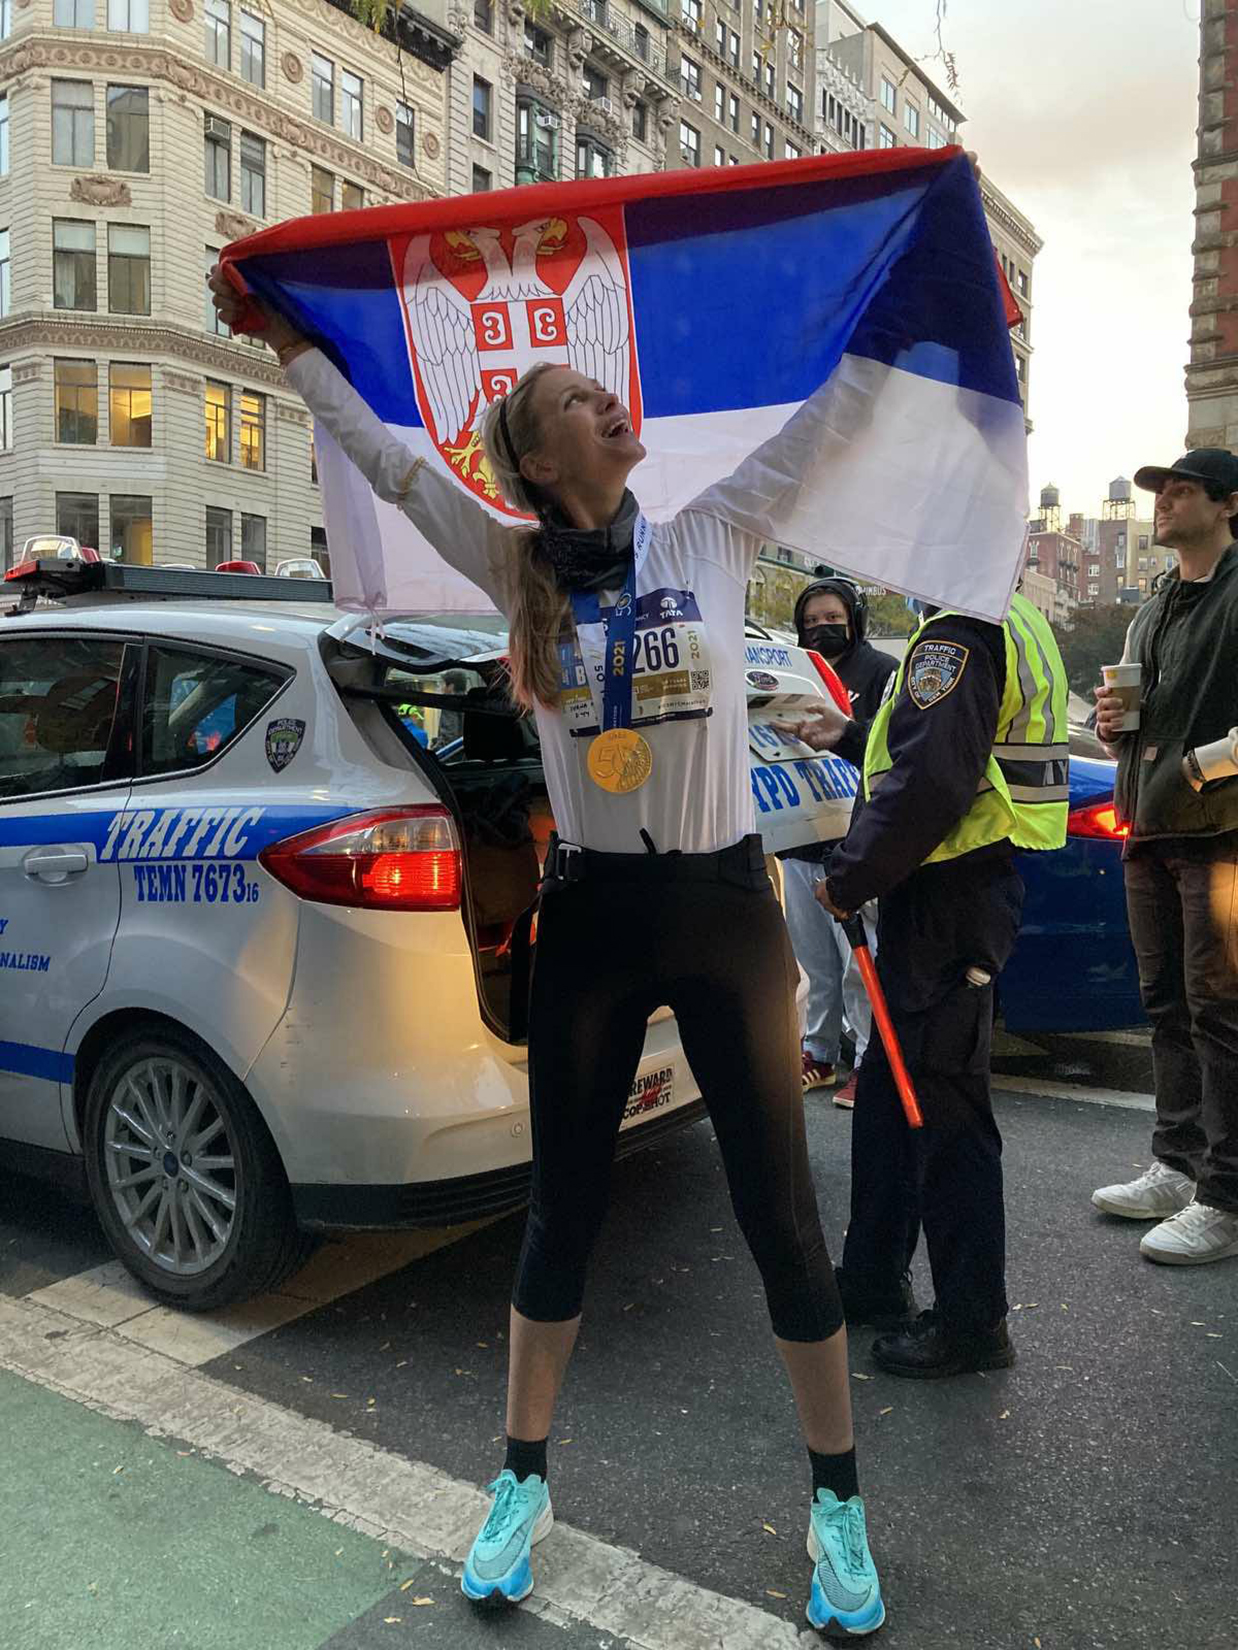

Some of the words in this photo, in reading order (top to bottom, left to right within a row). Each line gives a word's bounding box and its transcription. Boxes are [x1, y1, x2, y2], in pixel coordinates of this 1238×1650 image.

[659, 610, 684, 620] TATA
[690, 629, 700, 660] 2021
[924, 644, 957, 655] TRAFFIC
[612, 640, 626, 676] 2021
[915, 660, 957, 673] DEPARTMENT
[924, 655, 950, 663] POLICE
[101, 807, 266, 860] TRAFFIC
[134, 864, 187, 902] TEMN
[0, 952, 51, 972] NALISM
[627, 1068, 673, 1097] REWARD
